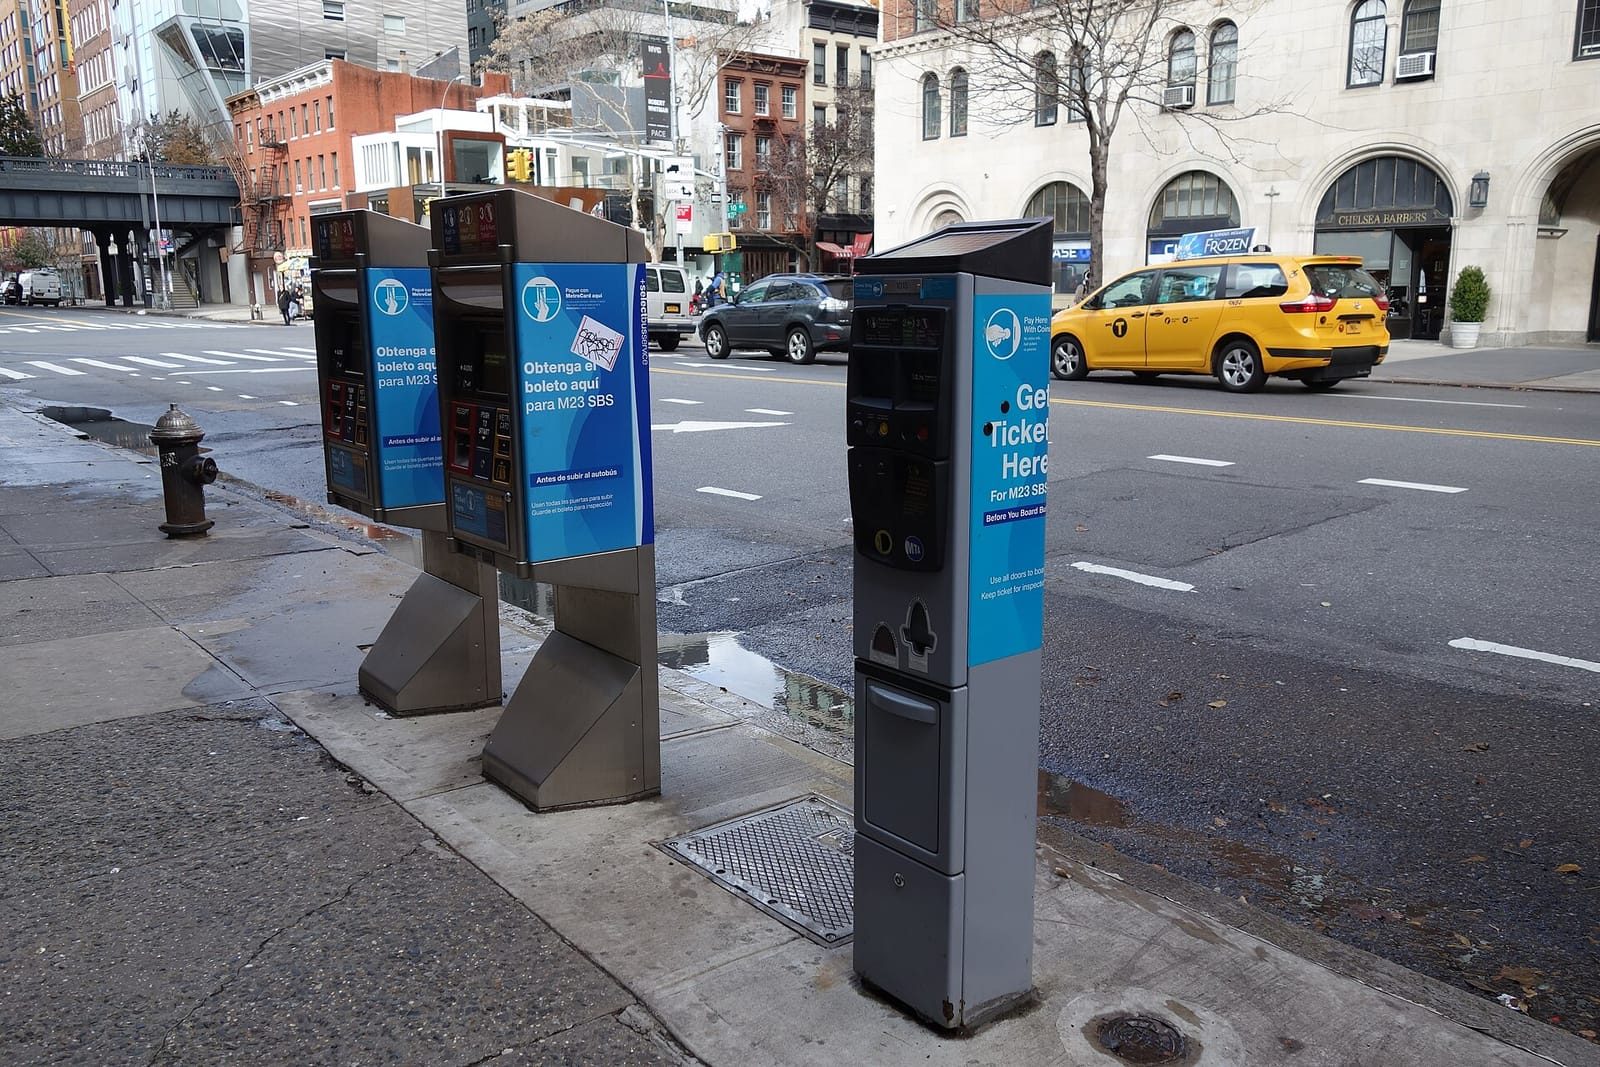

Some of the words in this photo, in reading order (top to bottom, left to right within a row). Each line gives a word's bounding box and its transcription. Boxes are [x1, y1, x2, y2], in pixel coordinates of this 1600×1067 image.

[651, 130, 666, 138] PACE
[459, 210, 464, 222] 2
[480, 207, 485, 220] 3
[1339, 214, 1380, 225] CHELSEA
[1383, 212, 1427, 224] BARBERS
[1204, 237, 1249, 254] FROZEN
[1024, 317, 1034, 325] Pay
[1115, 321, 1125, 336] T
[377, 347, 426, 358] Obtenga
[378, 362, 414, 372] boleto
[524, 362, 582, 374] Obtenga
[585, 362, 597, 372] el
[379, 378, 404, 388] para
[407, 375, 430, 385] M23
[525, 379, 565, 393] boleto
[570, 377, 599, 394] aquí
[526, 398, 556, 414] para
[557, 396, 585, 409] M23
[588, 394, 614, 407] SBS
[1002, 454, 1048, 479] Here
[536, 476, 556, 484] Antes
[567, 472, 583, 480] subir
[591, 469, 617, 477] autobús
[570, 497, 588, 505] puertas
[990, 490, 1007, 502] For
[1009, 486, 1030, 499] M23
[531, 508, 551, 516] Guarde
[558, 505, 573, 513] boleto
[986, 514, 1006, 523] Before
[1008, 511, 1019, 519] You
[1021, 507, 1038, 516] Board
[905, 540, 921, 554] MTA
[990, 576, 1001, 585] Use
[1010, 570, 1027, 580] doors
[1028, 569, 1034, 577] to
[981, 591, 996, 600] Keep
[997, 586, 1012, 597] ticket
